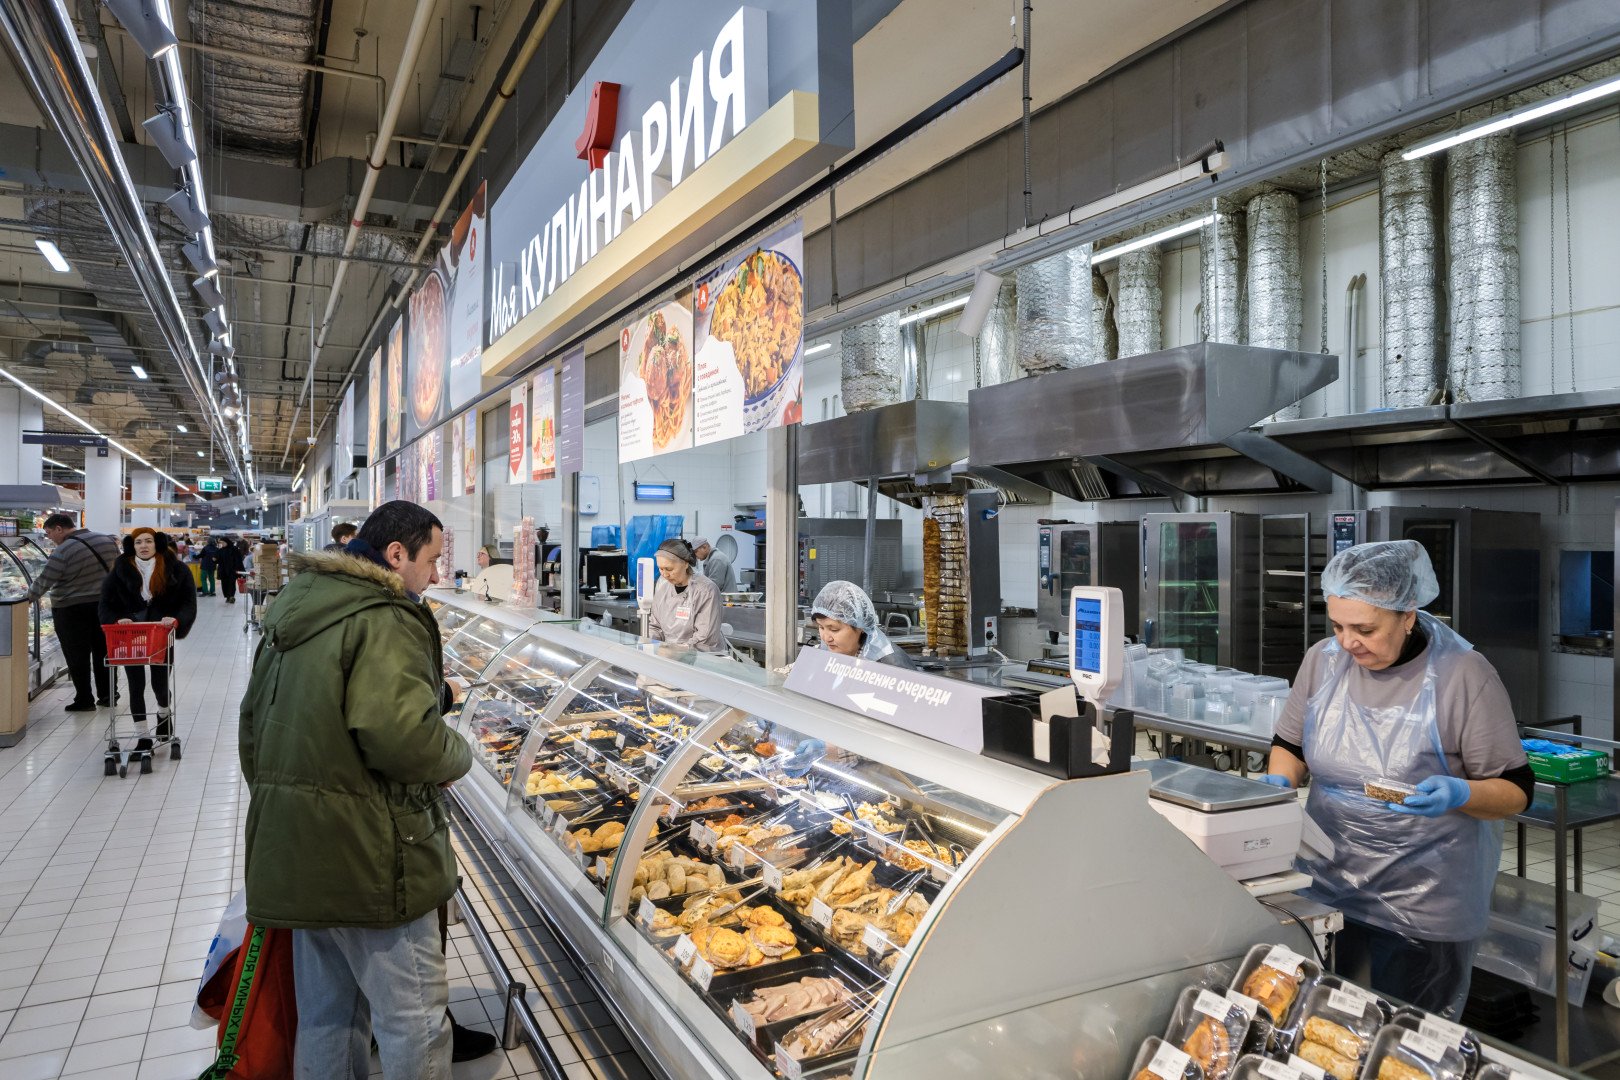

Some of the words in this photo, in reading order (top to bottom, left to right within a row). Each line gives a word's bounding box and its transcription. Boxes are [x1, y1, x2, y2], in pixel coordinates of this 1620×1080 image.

[489, 260, 519, 345] Моя
[521, 6, 747, 318] КУЛИНАРИЯ
[825, 656, 897, 690] Направление
[897, 679, 953, 706] очереди
[1596, 757, 1608, 768] 100
[244, 945, 260, 972] ДЛЯ
[229, 976, 252, 1029] УМНЫХ
[225, 1032, 238, 1042] И
